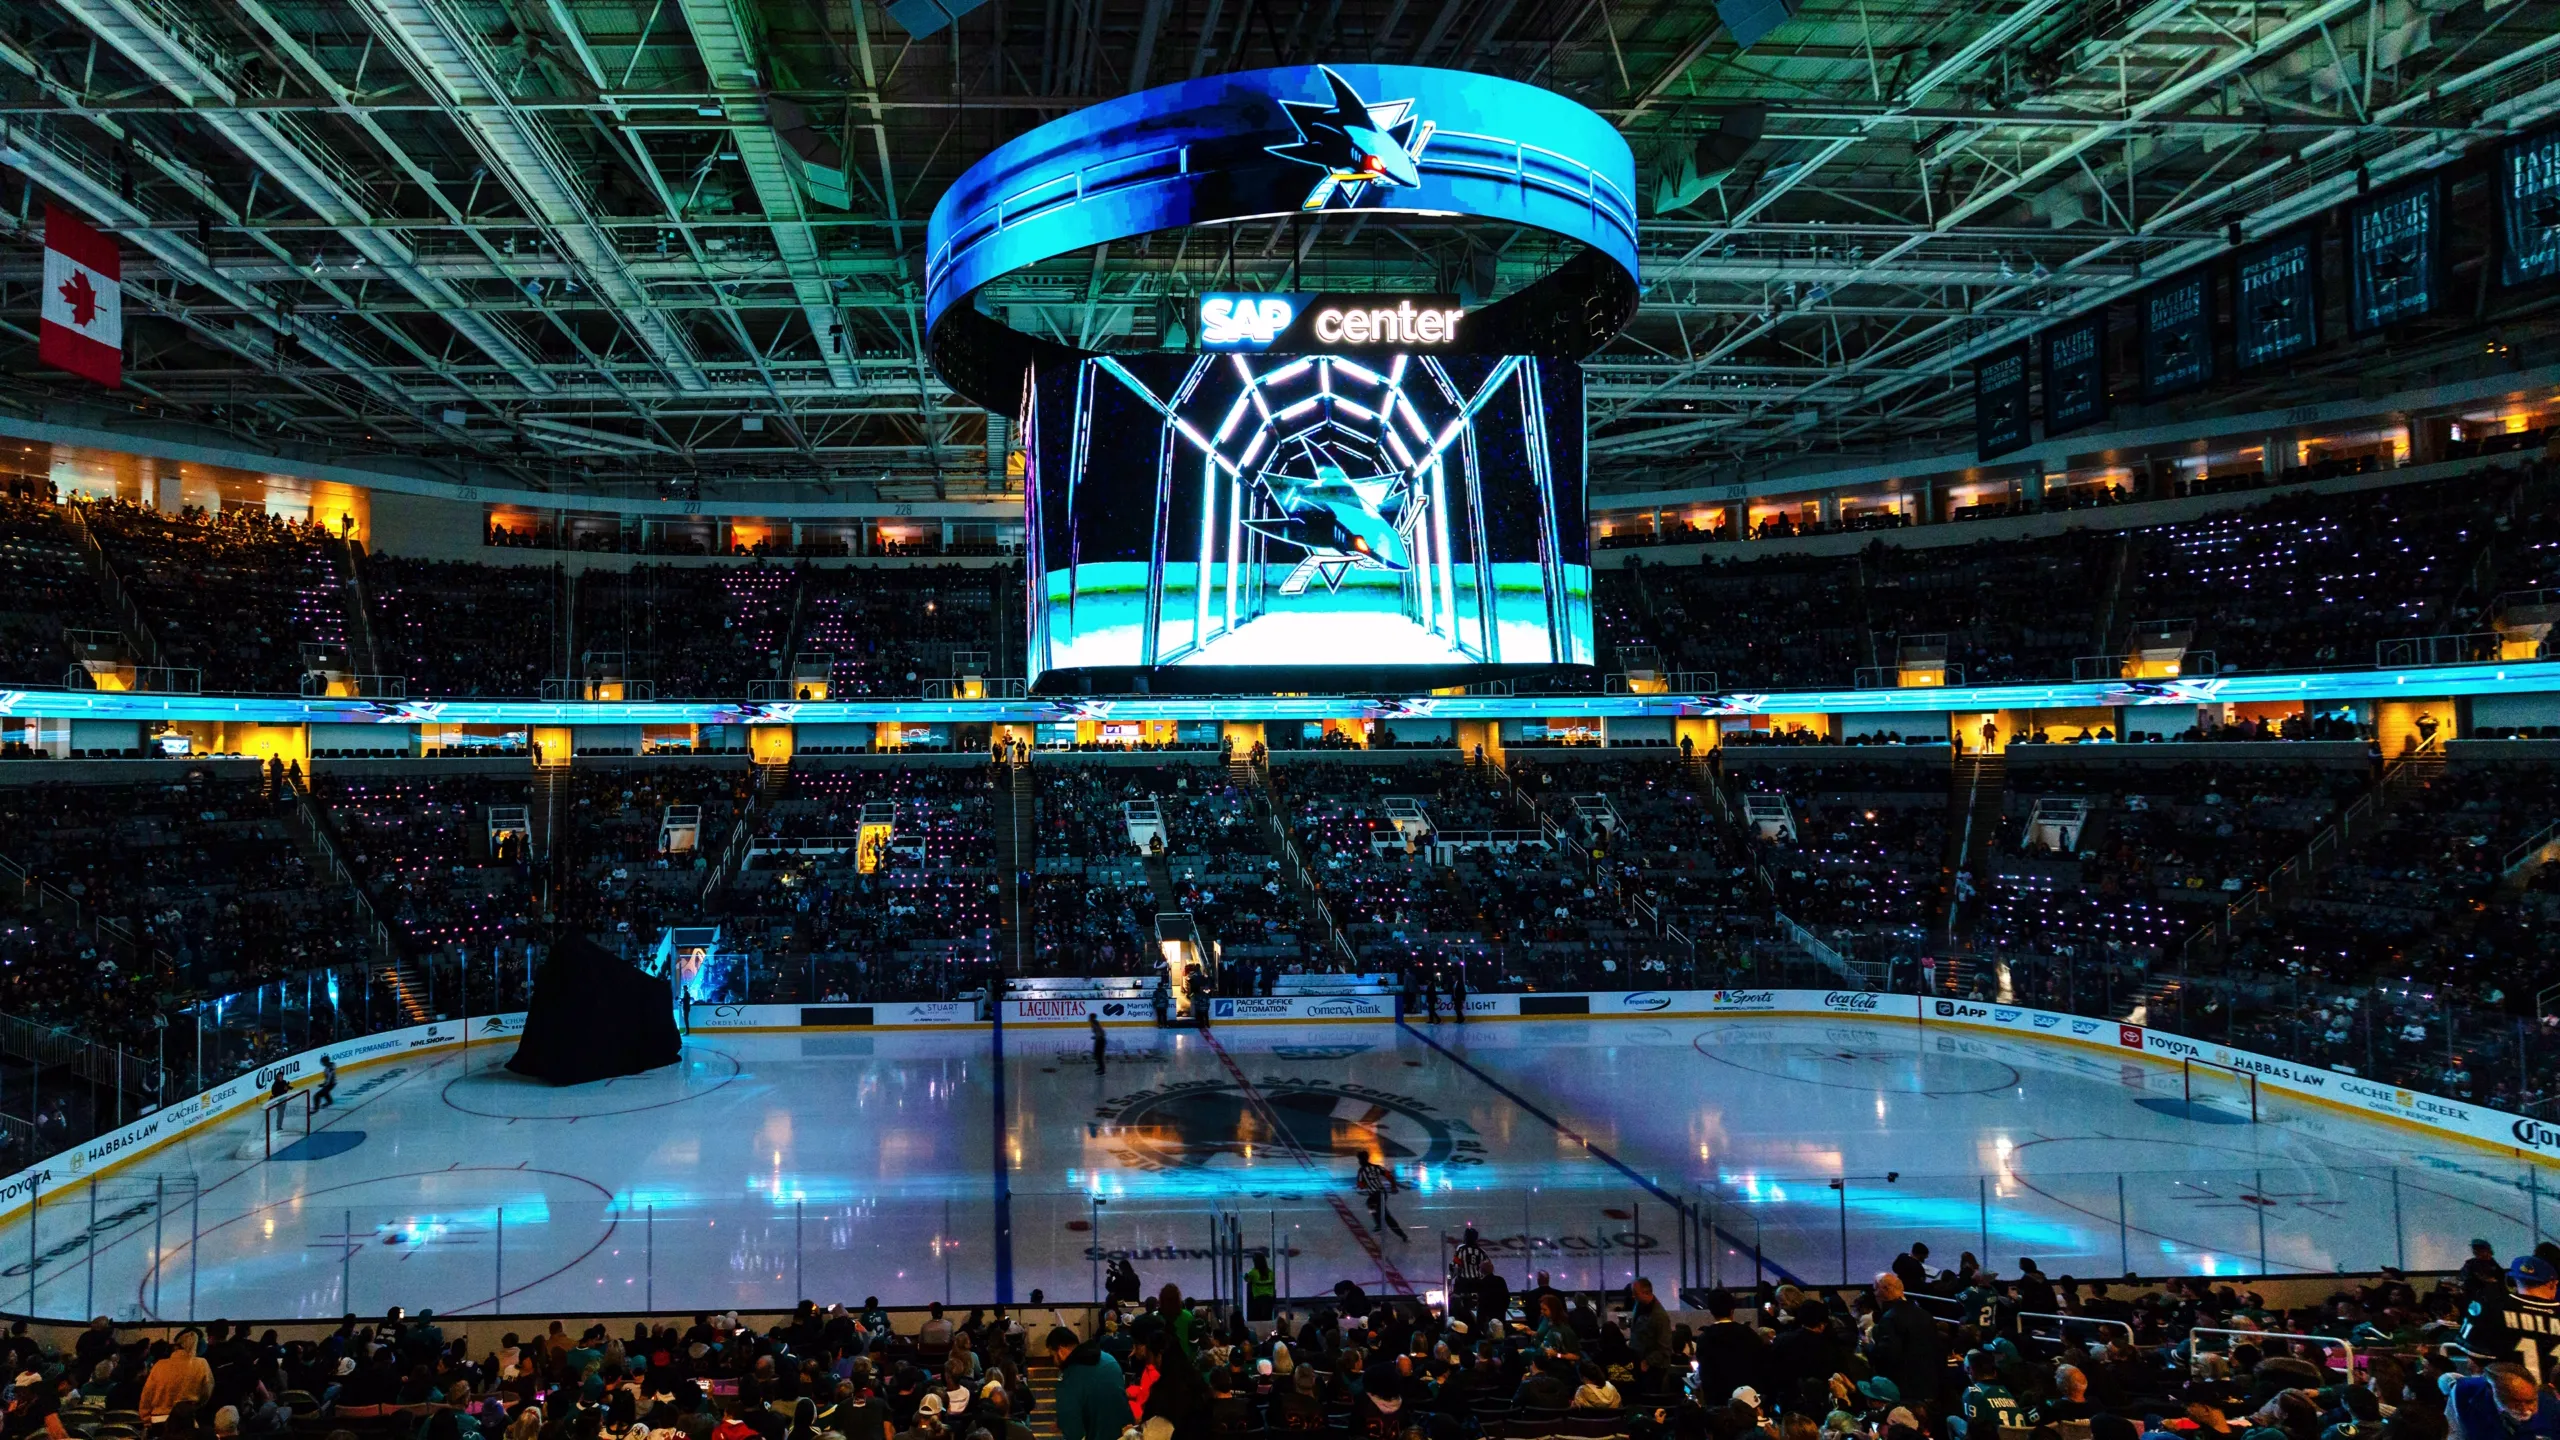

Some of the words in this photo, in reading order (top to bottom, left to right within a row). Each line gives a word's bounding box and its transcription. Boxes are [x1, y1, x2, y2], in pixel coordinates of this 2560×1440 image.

[2362, 192, 2429, 228] PACIFIC
[2362, 207, 2429, 242] DIVISION
[2242, 258, 2306, 293] TROPHY
[2151, 281, 2200, 311] PACIFIC
[2151, 295, 2200, 324] DIVISION
[1201, 299, 1292, 342] SAP
[1315, 300, 1464, 343] center
[2053, 326, 2095, 349] PACIFIC
[2053, 339, 2095, 362] DIVISION
[1981, 354, 2022, 377] WESTERN
[457, 485, 478, 500] 226
[1727, 485, 1747, 498] 204
[684, 502, 701, 514] 227
[895, 504, 912, 516] 228
[927, 1003, 958, 1011] STUART
[1236, 998, 1265, 1006] PACIFIC
[1466, 1001, 1497, 1010] LIGHT
[1731, 990, 1774, 1004] Sports
[1824, 991, 1879, 1008] Coca-Cola
[1019, 1001, 1086, 1017] LAGUNITAS
[1237, 1005, 1287, 1013] AUTOMATION
[1356, 1005, 1381, 1014] Bank
[1995, 1010, 2016, 1020] SAP
[2034, 1016, 2055, 1026] SAP
[2072, 1022, 2094, 1032] SAP
[332, 1049, 353, 1061] KAISER
[354, 1039, 399, 1056] PERMANENTE
[2147, 1036, 2199, 1056] TOYOTA
[256, 1060, 301, 1090] Corona
[2234, 1056, 2290, 1079] HABBAS
[2294, 1071, 2325, 1087] LAW
[1112, 1088, 1158, 1107] San
[1160, 1079, 1225, 1092] Jose
[1263, 1076, 1331, 1086] SAP
[1339, 1083, 1439, 1111] Center
[2340, 1082, 2393, 1101] CACHE
[2416, 1100, 2470, 1121] CREEK
[166, 1102, 200, 1123] CACHE
[211, 1086, 238, 1105] CREEK
[88, 1133, 134, 1162] HABBAS
[136, 1121, 159, 1142] LAW
[0, 1169, 51, 1201] TOYOTA
[1963, 1403, 1977, 1418] 19
